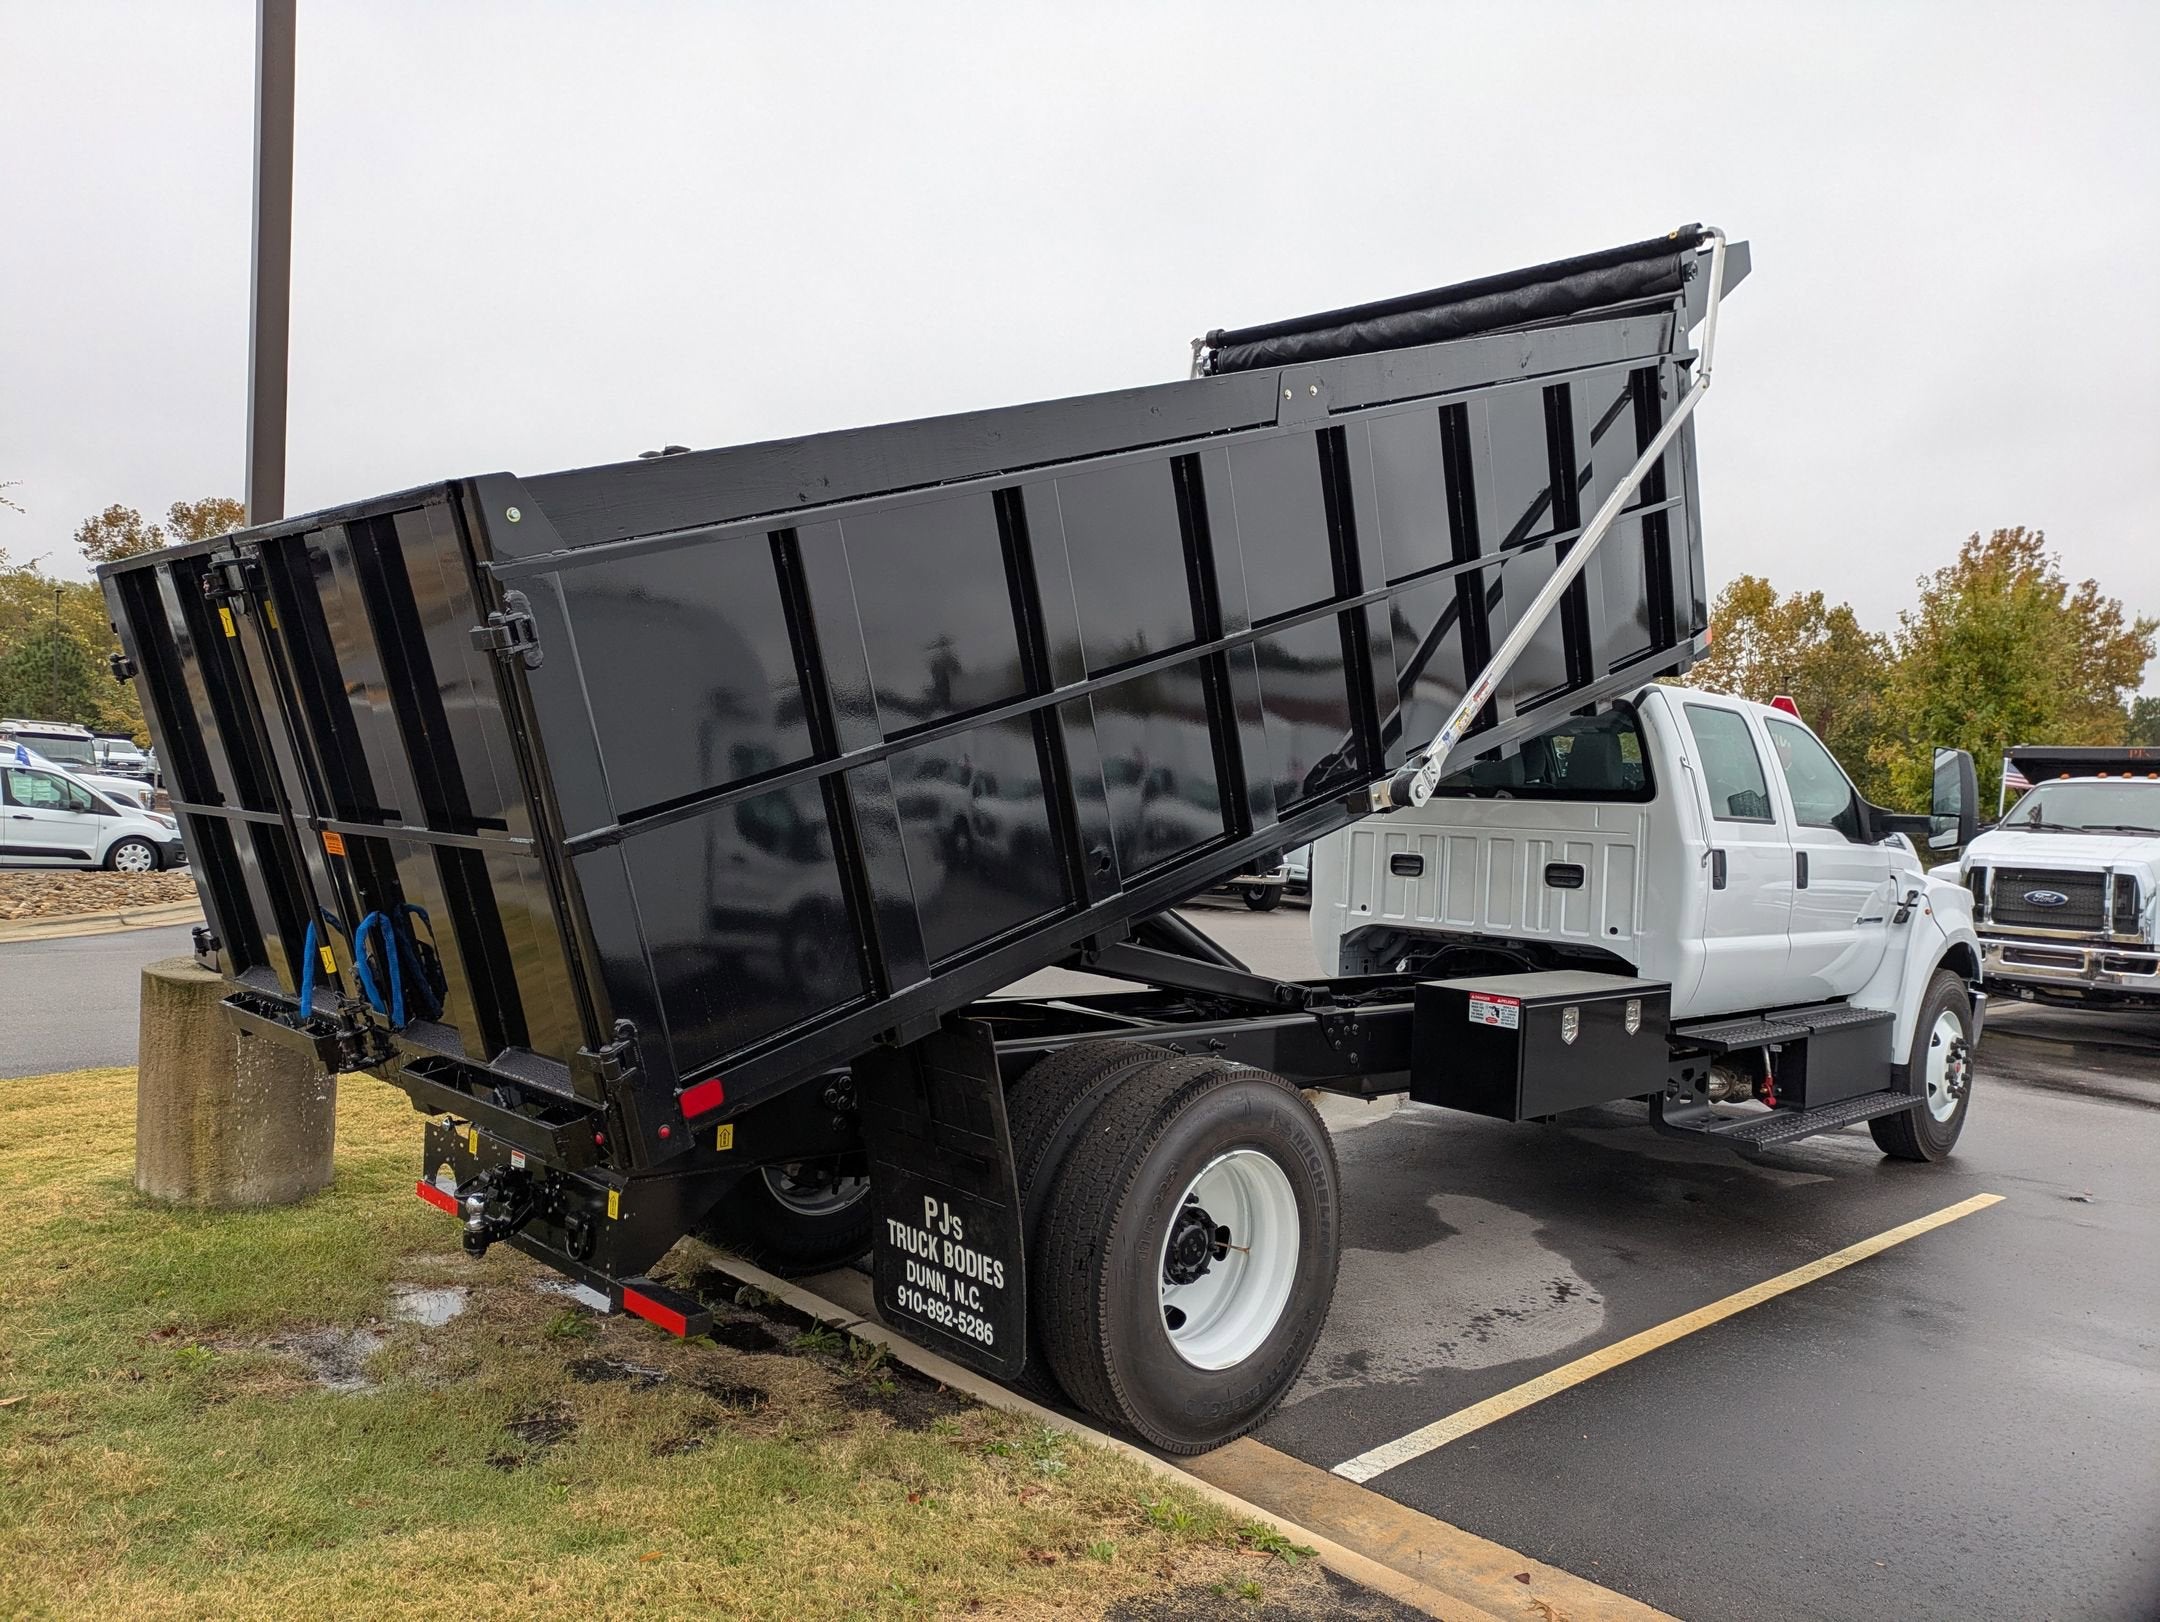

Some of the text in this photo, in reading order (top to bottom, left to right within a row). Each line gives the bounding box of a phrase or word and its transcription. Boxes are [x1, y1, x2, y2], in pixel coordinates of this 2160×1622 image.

[1294, 1130, 1331, 1256] MICHELIN
[887, 1218, 1005, 1289] TRUCK BODIES
[906, 1259, 984, 1312] DUNN, N.C.
[897, 1285, 994, 1345] 910-892-5286
